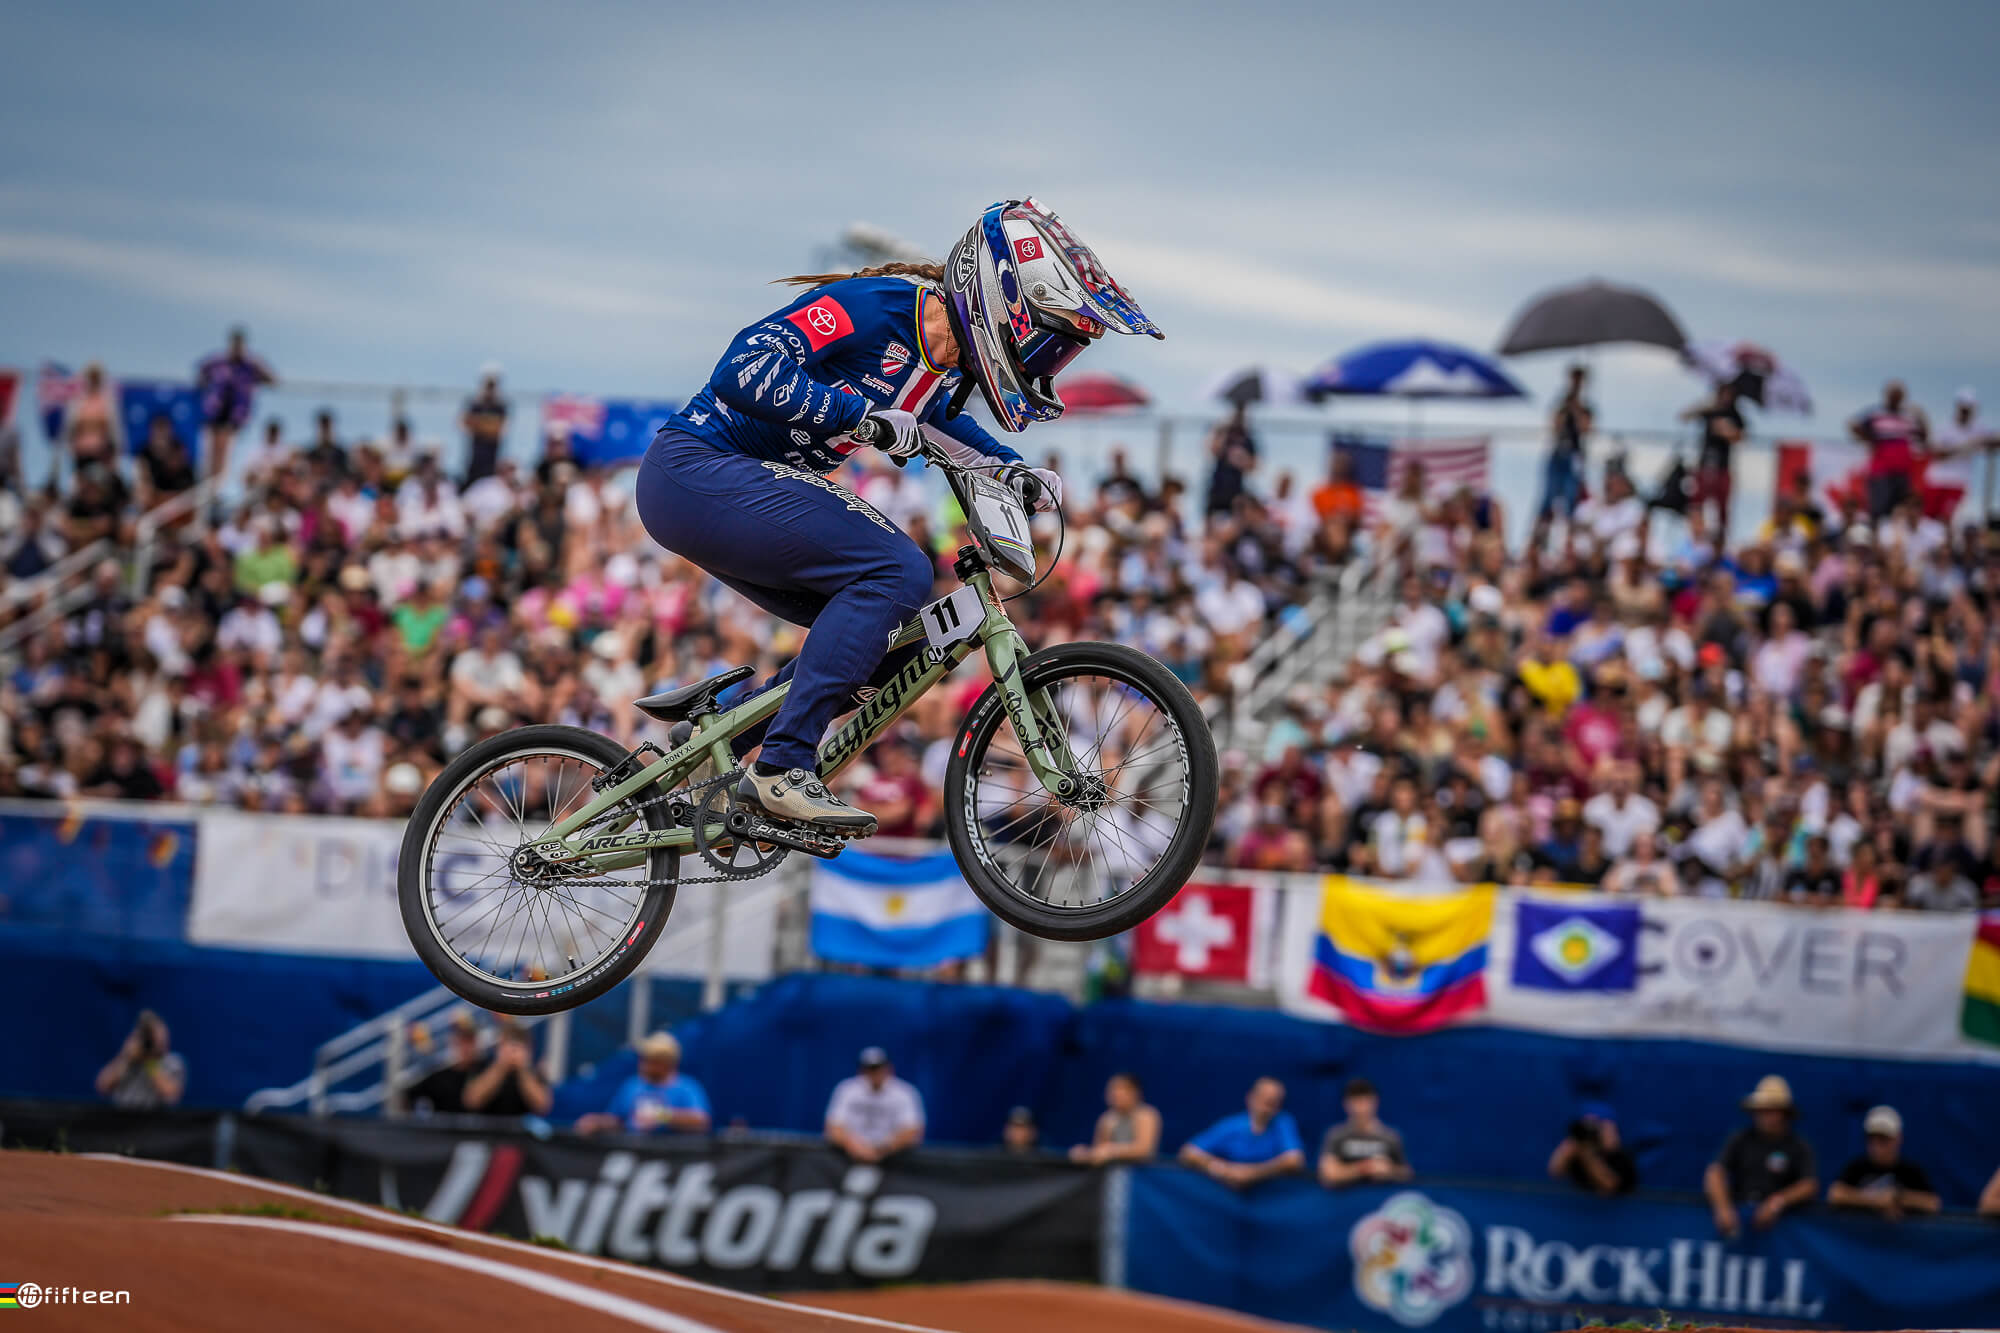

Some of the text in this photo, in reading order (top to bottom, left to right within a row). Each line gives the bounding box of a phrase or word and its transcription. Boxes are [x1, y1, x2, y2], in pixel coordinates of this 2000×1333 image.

[759, 322, 806, 367] TOYOTA
[889, 343, 908, 357] USA
[800, 378, 815, 414] ONYX
[819, 391, 832, 414] box
[999, 503, 1023, 541] 11
[929, 597, 961, 635] 11
[664, 744, 696, 766] PONY XL
[579, 834, 627, 851] ARC
[519, 1150, 938, 1278] vittoria
